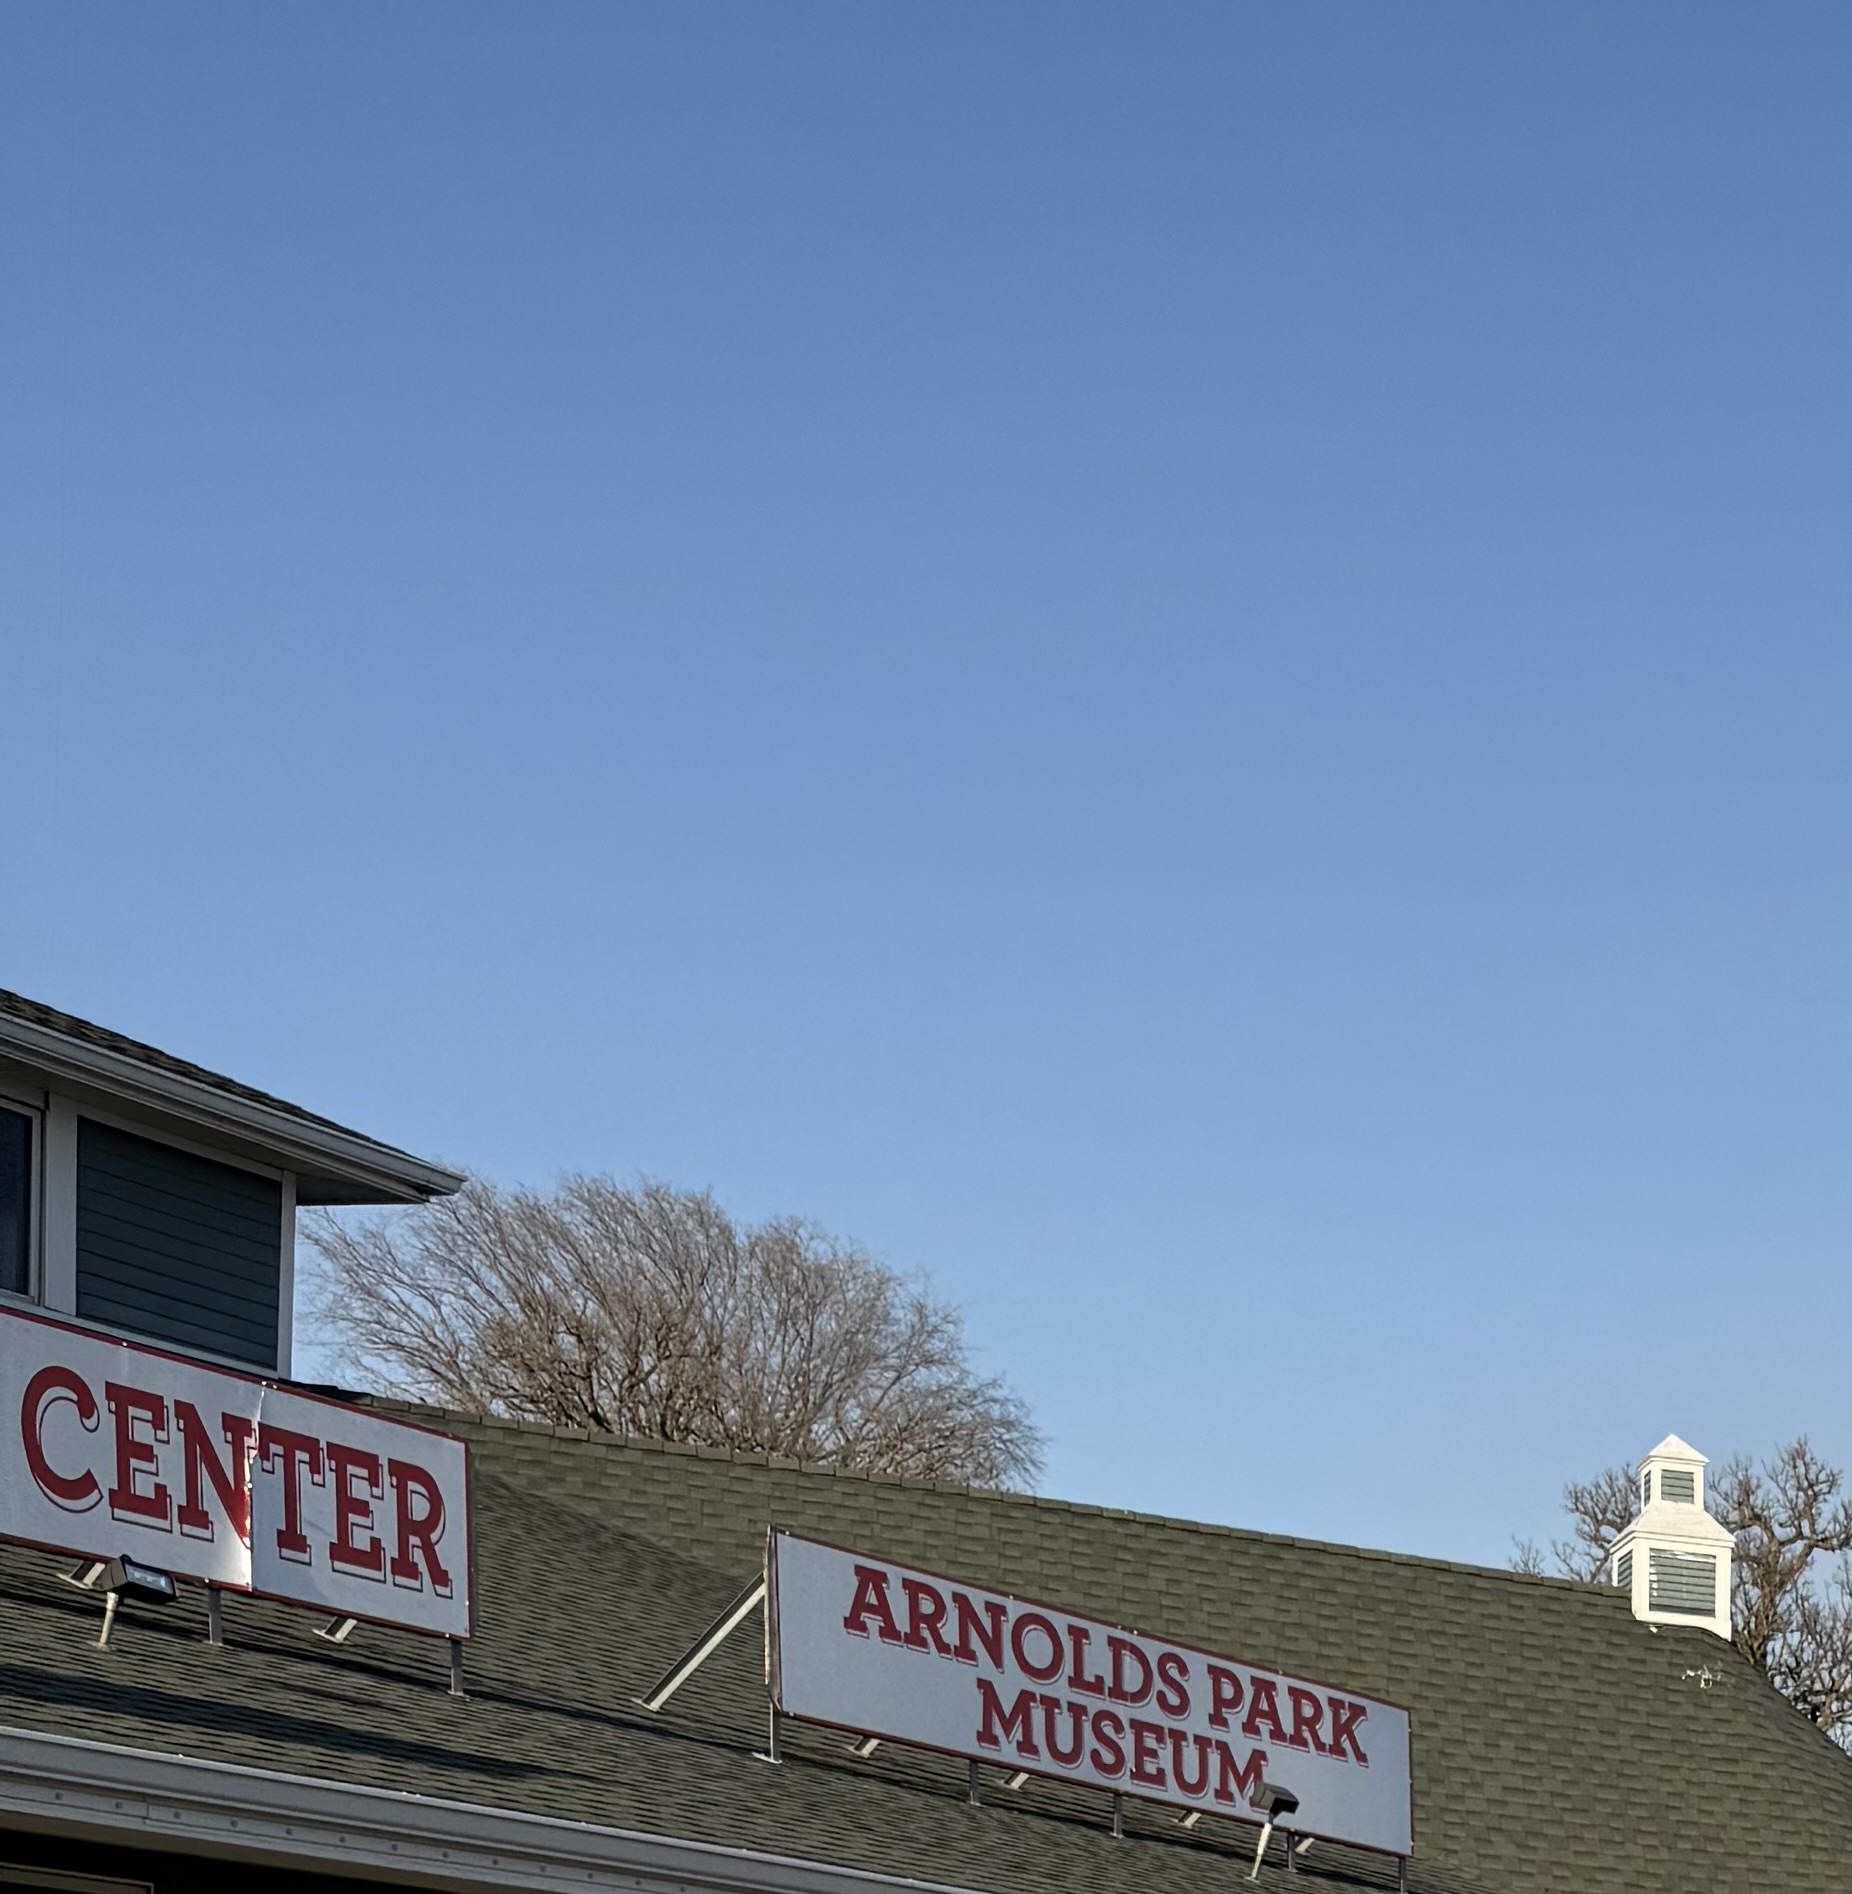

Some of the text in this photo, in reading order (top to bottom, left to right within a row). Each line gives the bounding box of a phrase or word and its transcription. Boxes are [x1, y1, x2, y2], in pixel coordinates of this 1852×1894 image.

[20, 1365, 454, 1599] CENTER
[843, 1564, 1369, 1767] ARNOLDS PARK
[975, 1679, 1268, 1812] MUSEUM
